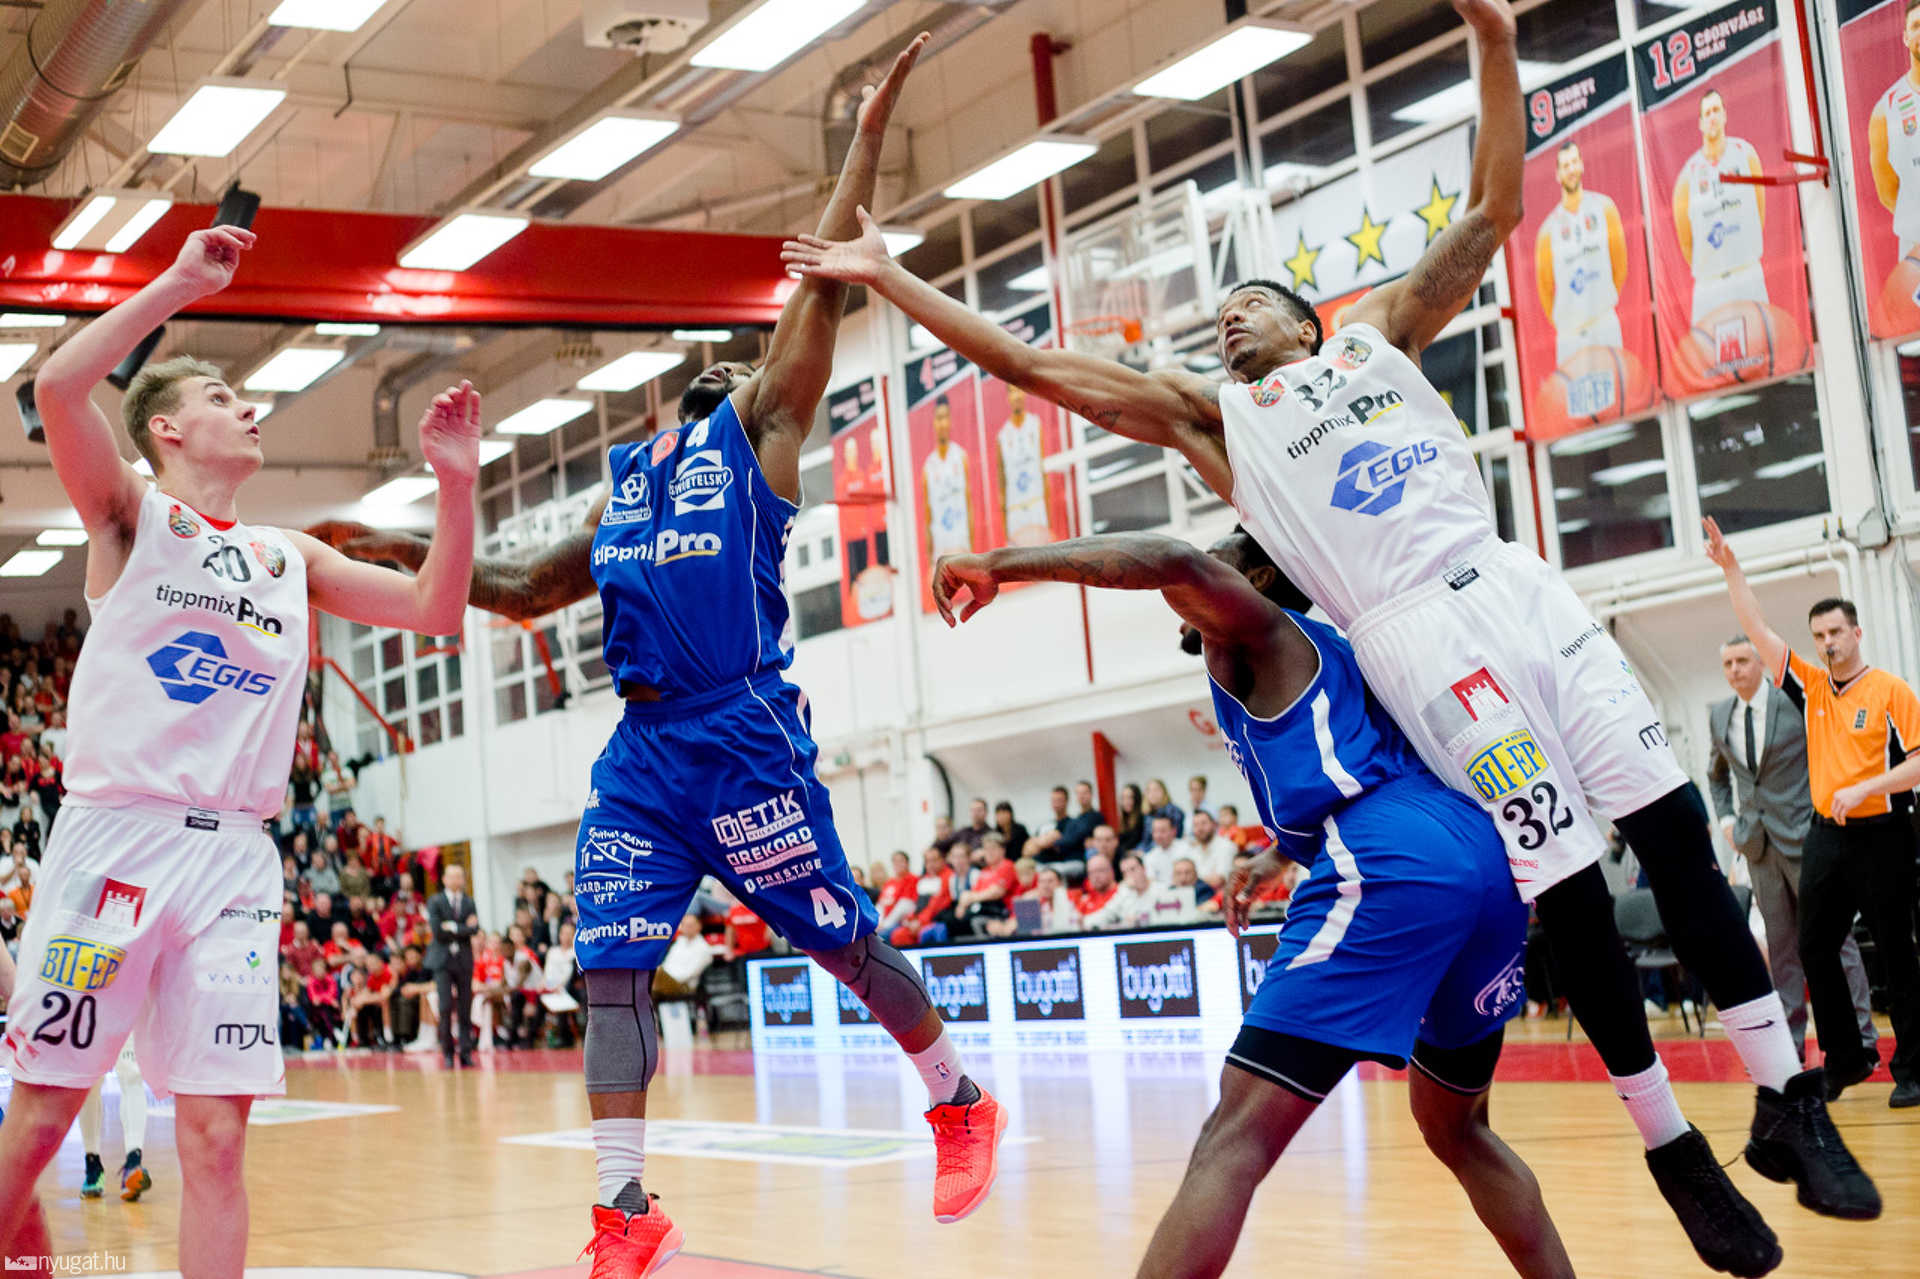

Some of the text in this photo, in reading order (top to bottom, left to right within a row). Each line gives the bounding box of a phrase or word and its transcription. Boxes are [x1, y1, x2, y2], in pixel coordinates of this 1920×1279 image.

[1648, 30, 1696, 91] 12
[1530, 89, 1555, 138] 9
[686, 418, 710, 447] 4
[1367, 439, 1438, 488] EGIS
[202, 534, 252, 583] 20
[156, 584, 283, 636] tippmixPro
[188, 657, 276, 696] EGIS
[1466, 740, 1541, 800] BIT-EP
[1502, 781, 1574, 850] 32
[810, 887, 846, 928] 4
[41, 938, 119, 990] BIT-EP
[33, 991, 96, 1049] 20
